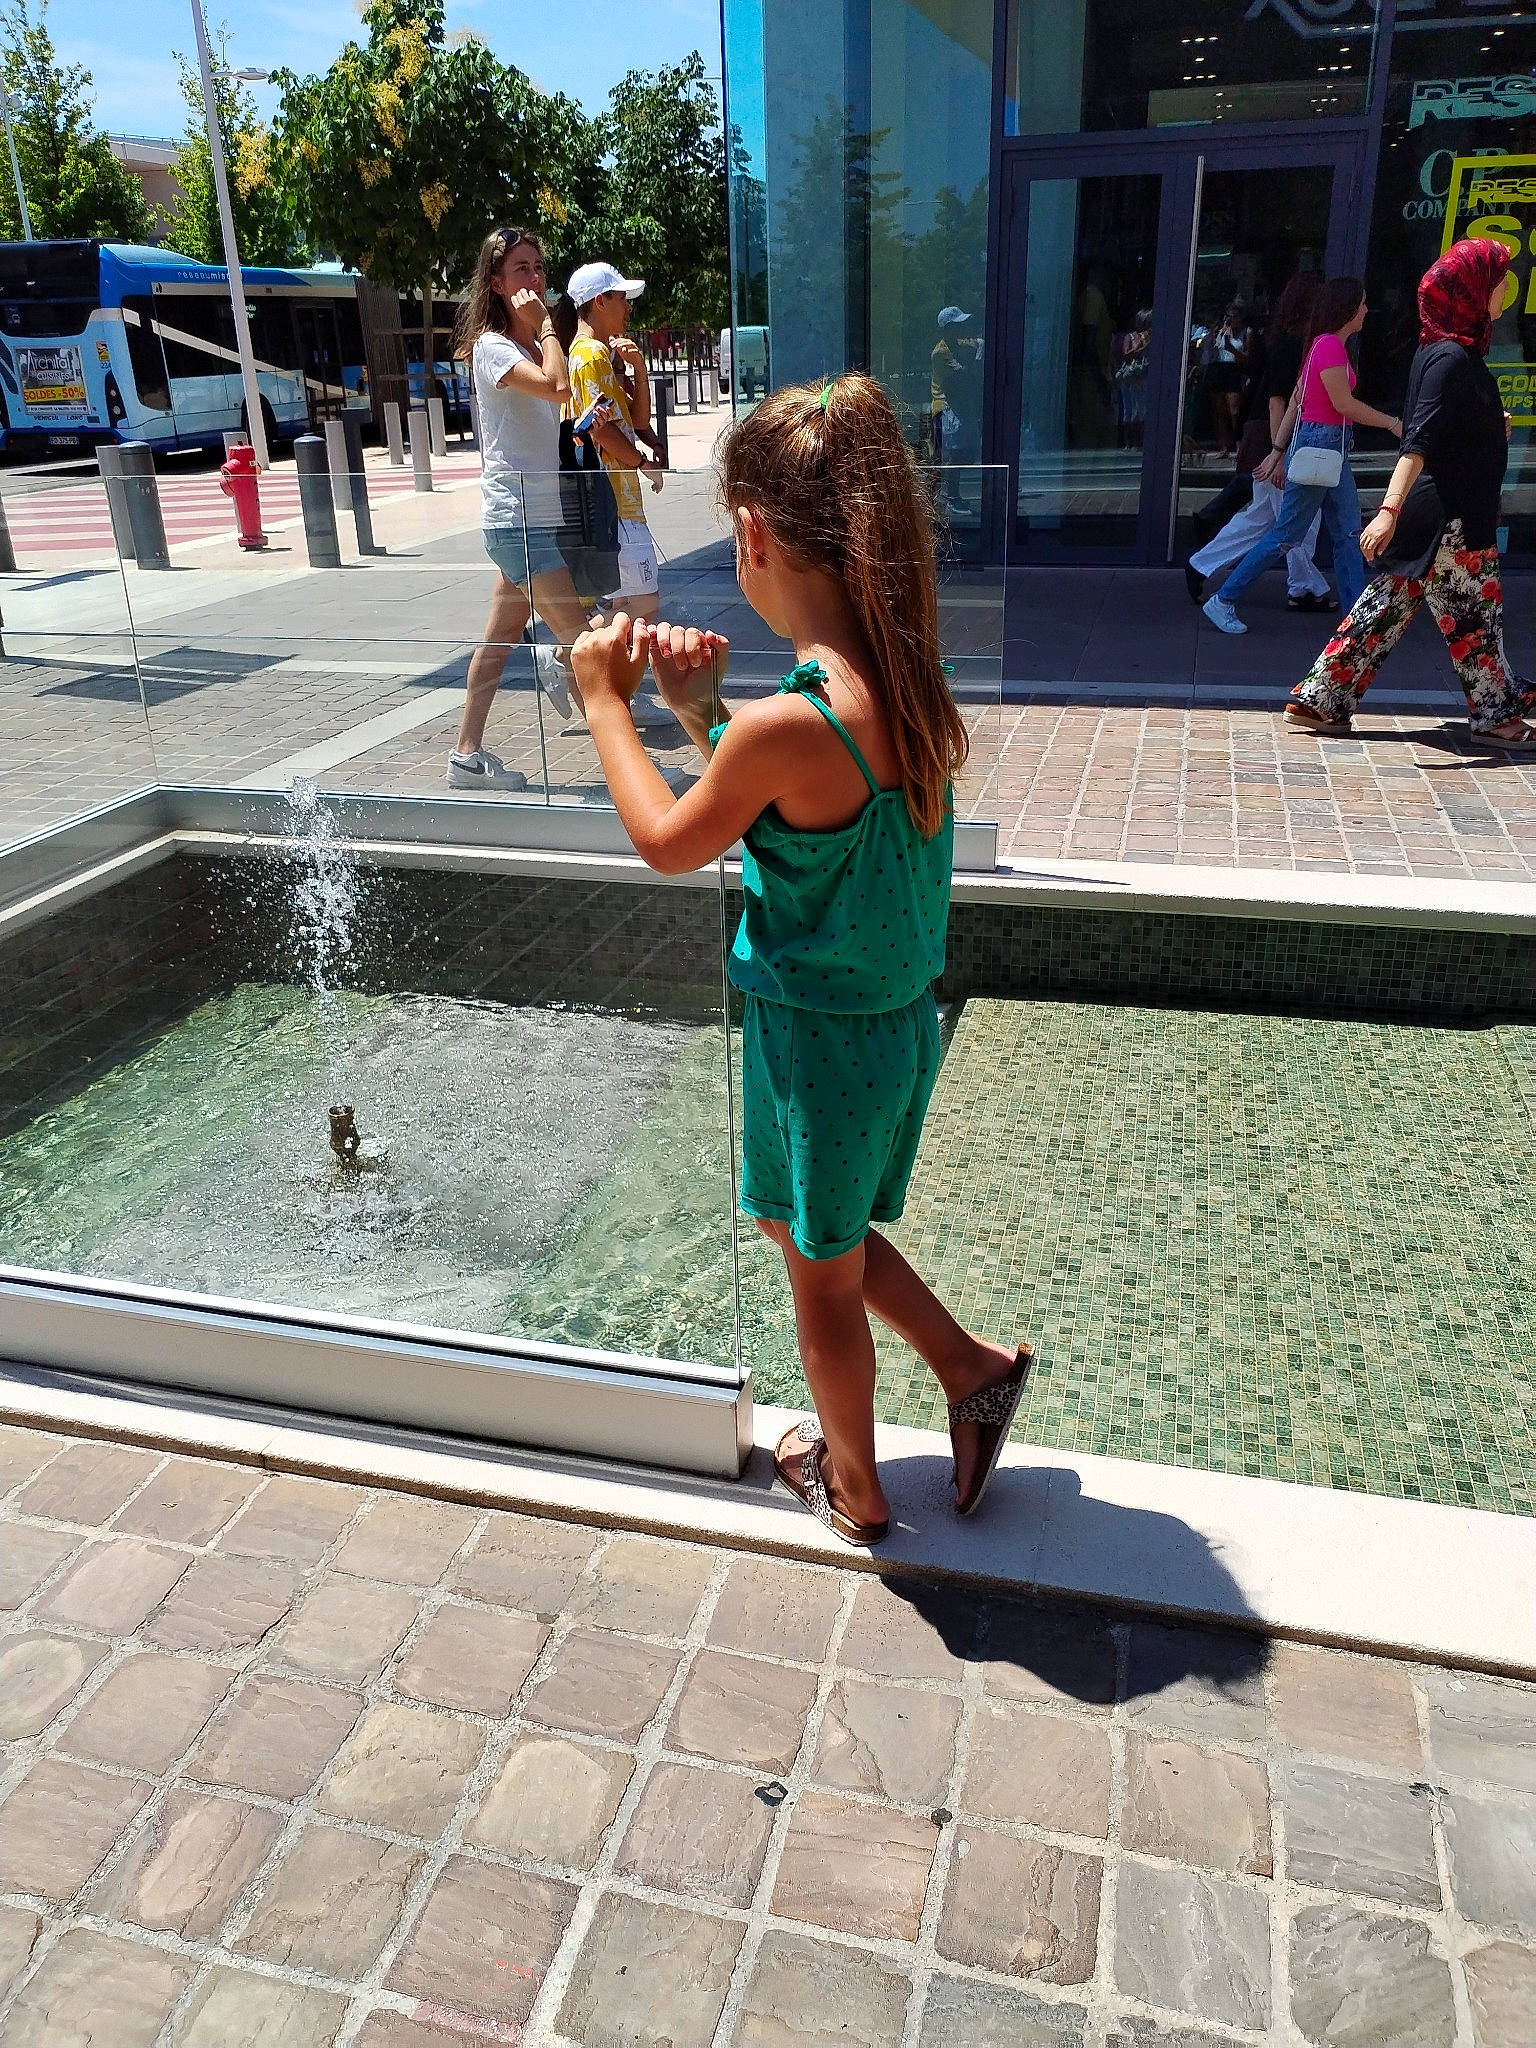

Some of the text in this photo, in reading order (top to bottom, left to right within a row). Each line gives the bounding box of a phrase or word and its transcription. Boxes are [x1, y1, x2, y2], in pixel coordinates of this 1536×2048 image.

[1402, 199, 1513, 221] COMPANY
[37, 373, 70, 381] CUISINES
[24, 386, 85, 401] SOLDES -50%
